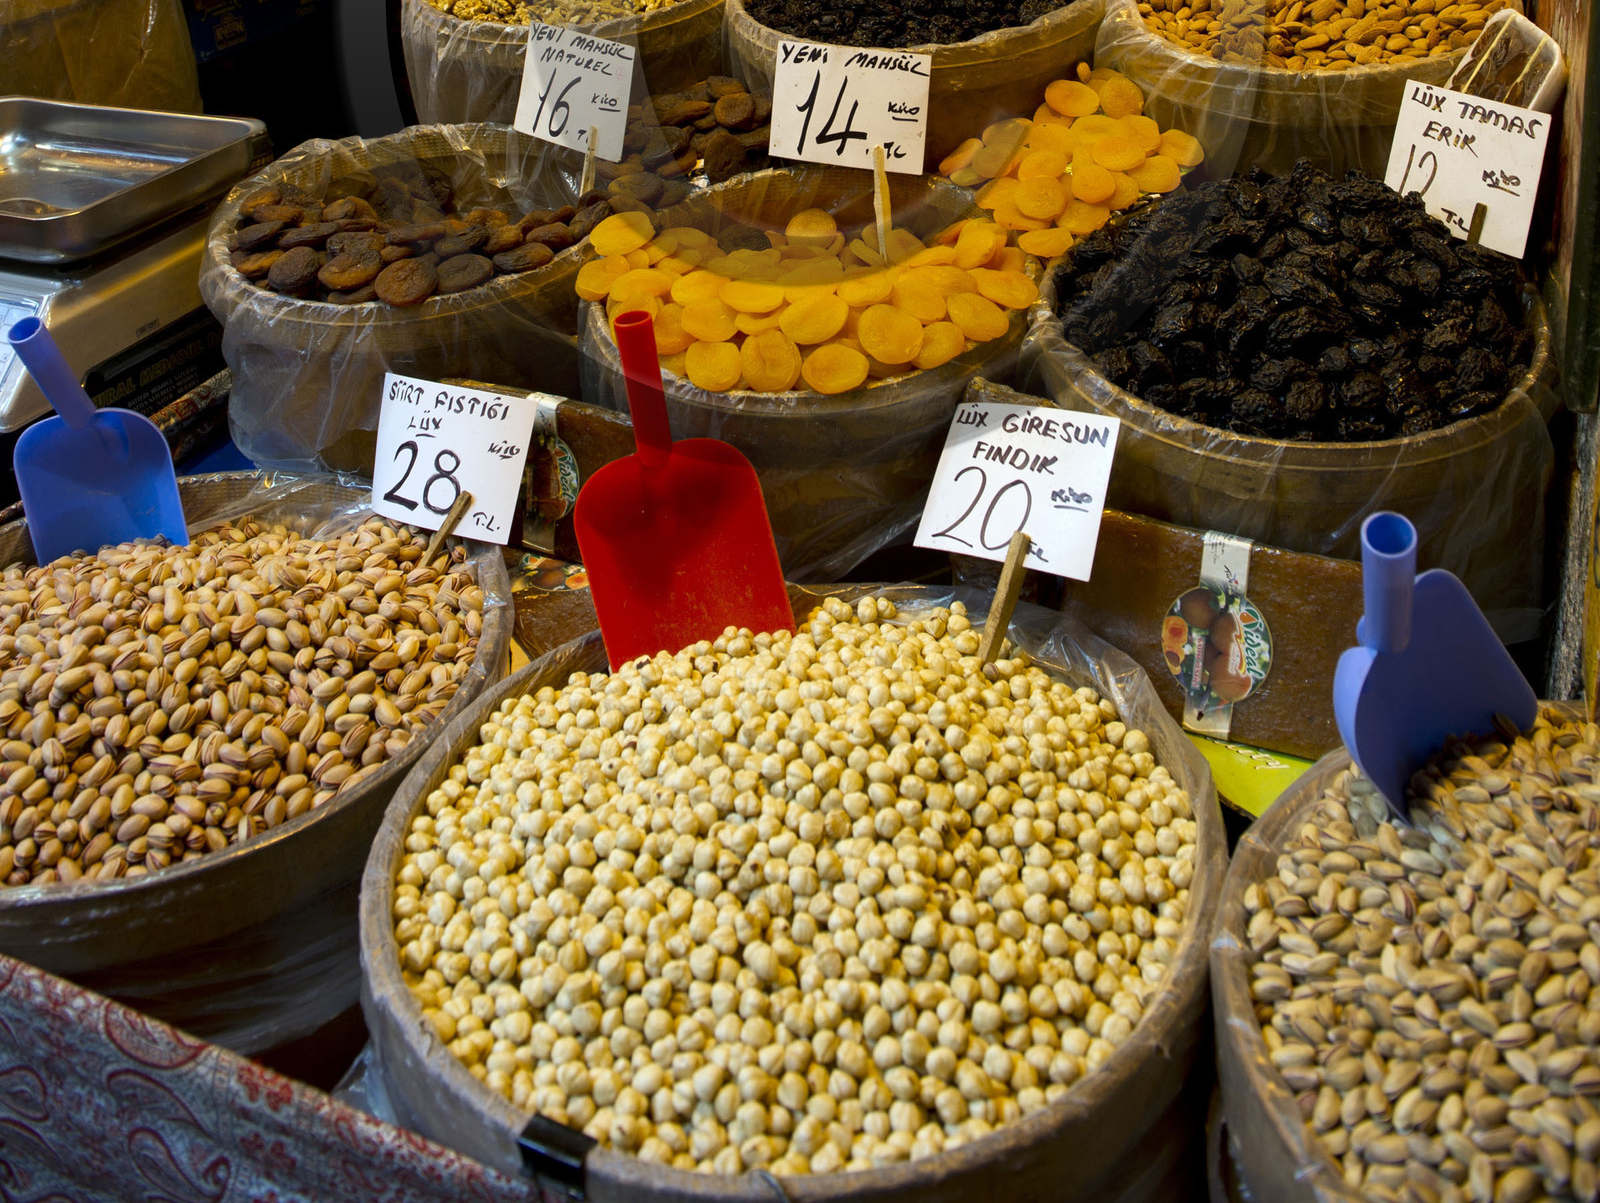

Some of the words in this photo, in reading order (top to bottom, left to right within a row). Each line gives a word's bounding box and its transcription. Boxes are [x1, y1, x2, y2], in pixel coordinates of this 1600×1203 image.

[540, 46, 613, 76] NATUREL
[782, 43, 828, 64] YENİ
[844, 52, 930, 77] MAHSÜL
[1411, 85, 1447, 114] LÜX
[1458, 101, 1543, 140] TAMAS
[1422, 120, 1480, 159] ERİK
[406, 410, 443, 431] LÜX
[956, 403, 989, 428] LÜX
[1001, 410, 1110, 448] GİRESUN
[972, 441, 1059, 475] FINDIK
[383, 440, 461, 516] 28
[931, 466, 1032, 551] 20
